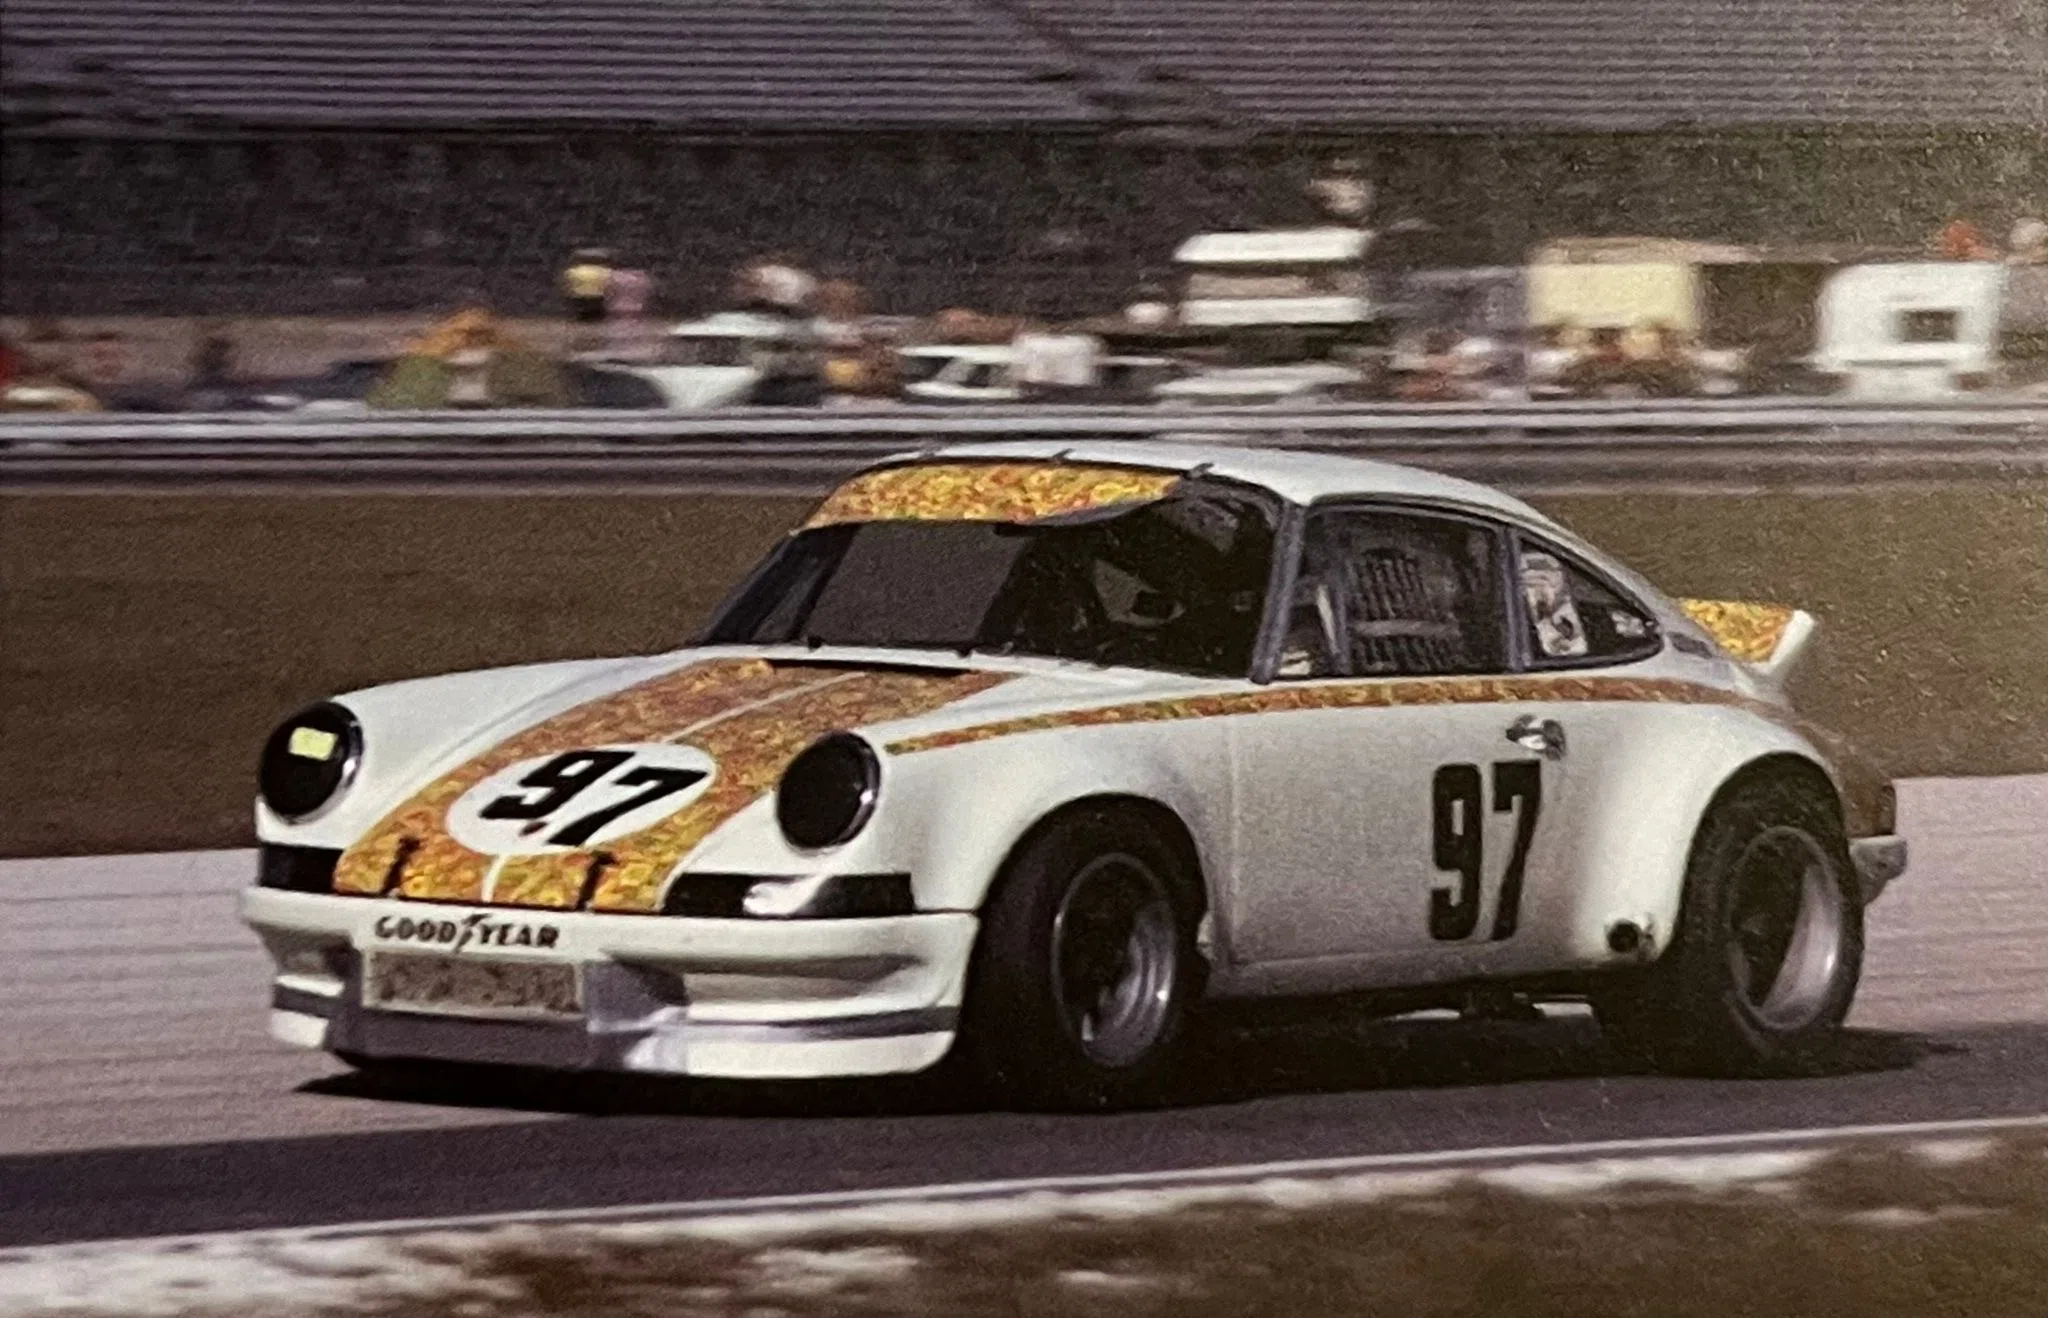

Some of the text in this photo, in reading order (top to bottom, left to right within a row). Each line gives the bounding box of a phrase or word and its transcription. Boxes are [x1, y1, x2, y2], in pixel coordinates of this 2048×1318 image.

[479, 750, 708, 847] 97
[1429, 761, 1541, 941] 97
[375, 913, 560, 952] GOODYEAR
